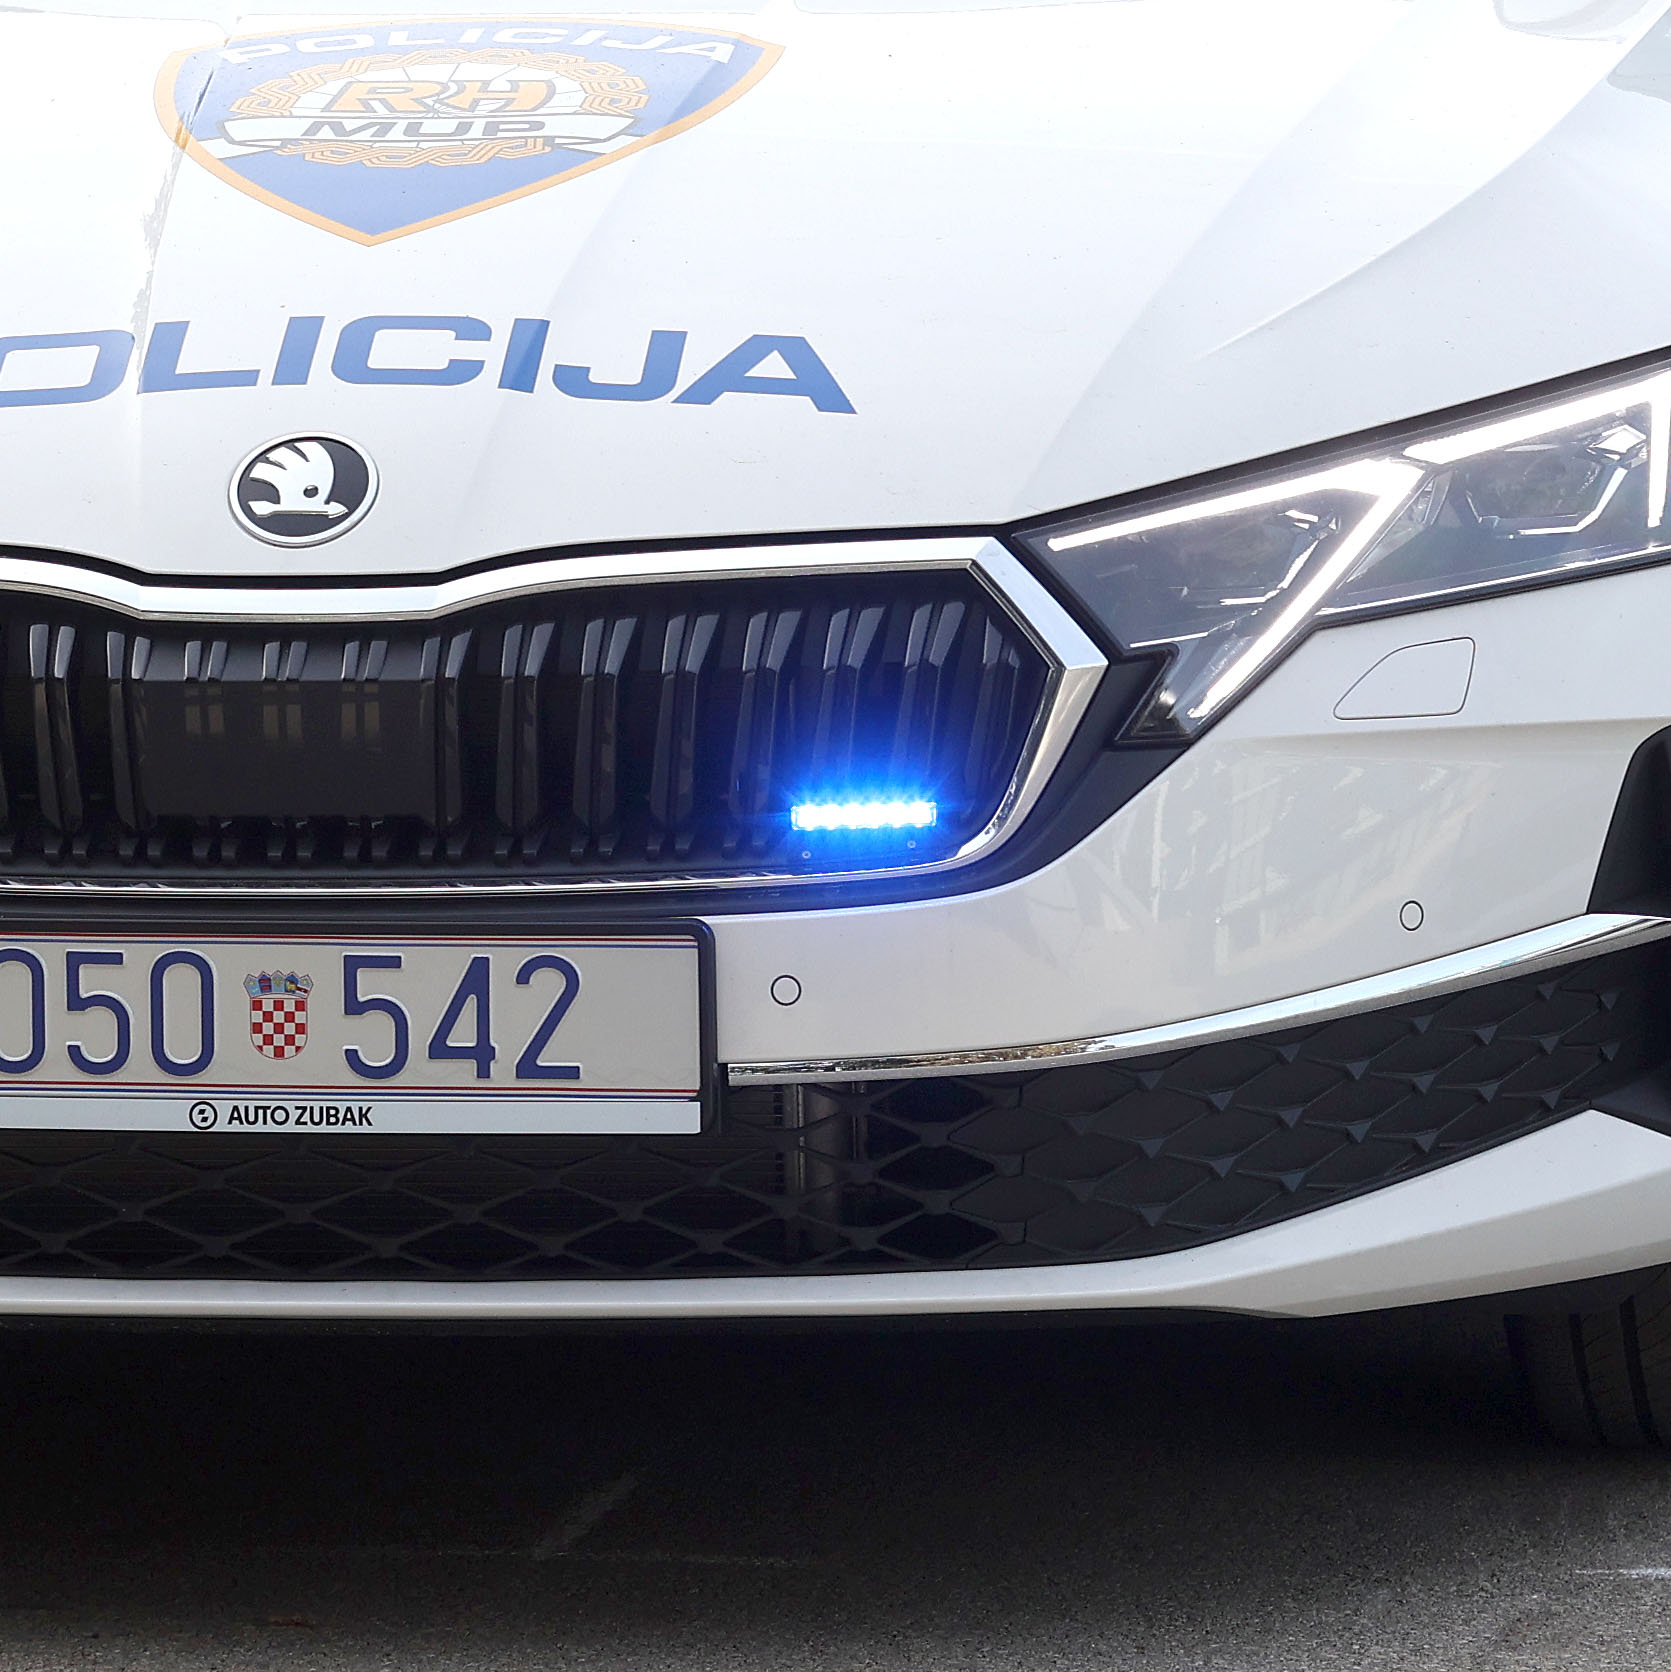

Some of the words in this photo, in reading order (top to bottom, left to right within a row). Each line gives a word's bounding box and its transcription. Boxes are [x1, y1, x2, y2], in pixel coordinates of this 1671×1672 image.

[216, 27, 739, 64] POLICIJA
[321, 79, 557, 114] RH
[300, 120, 547, 138] MUP
[340, 953, 583, 1080] 542
[227, 1104, 291, 1127] AUTO
[293, 1104, 374, 1128] ZUBAK
